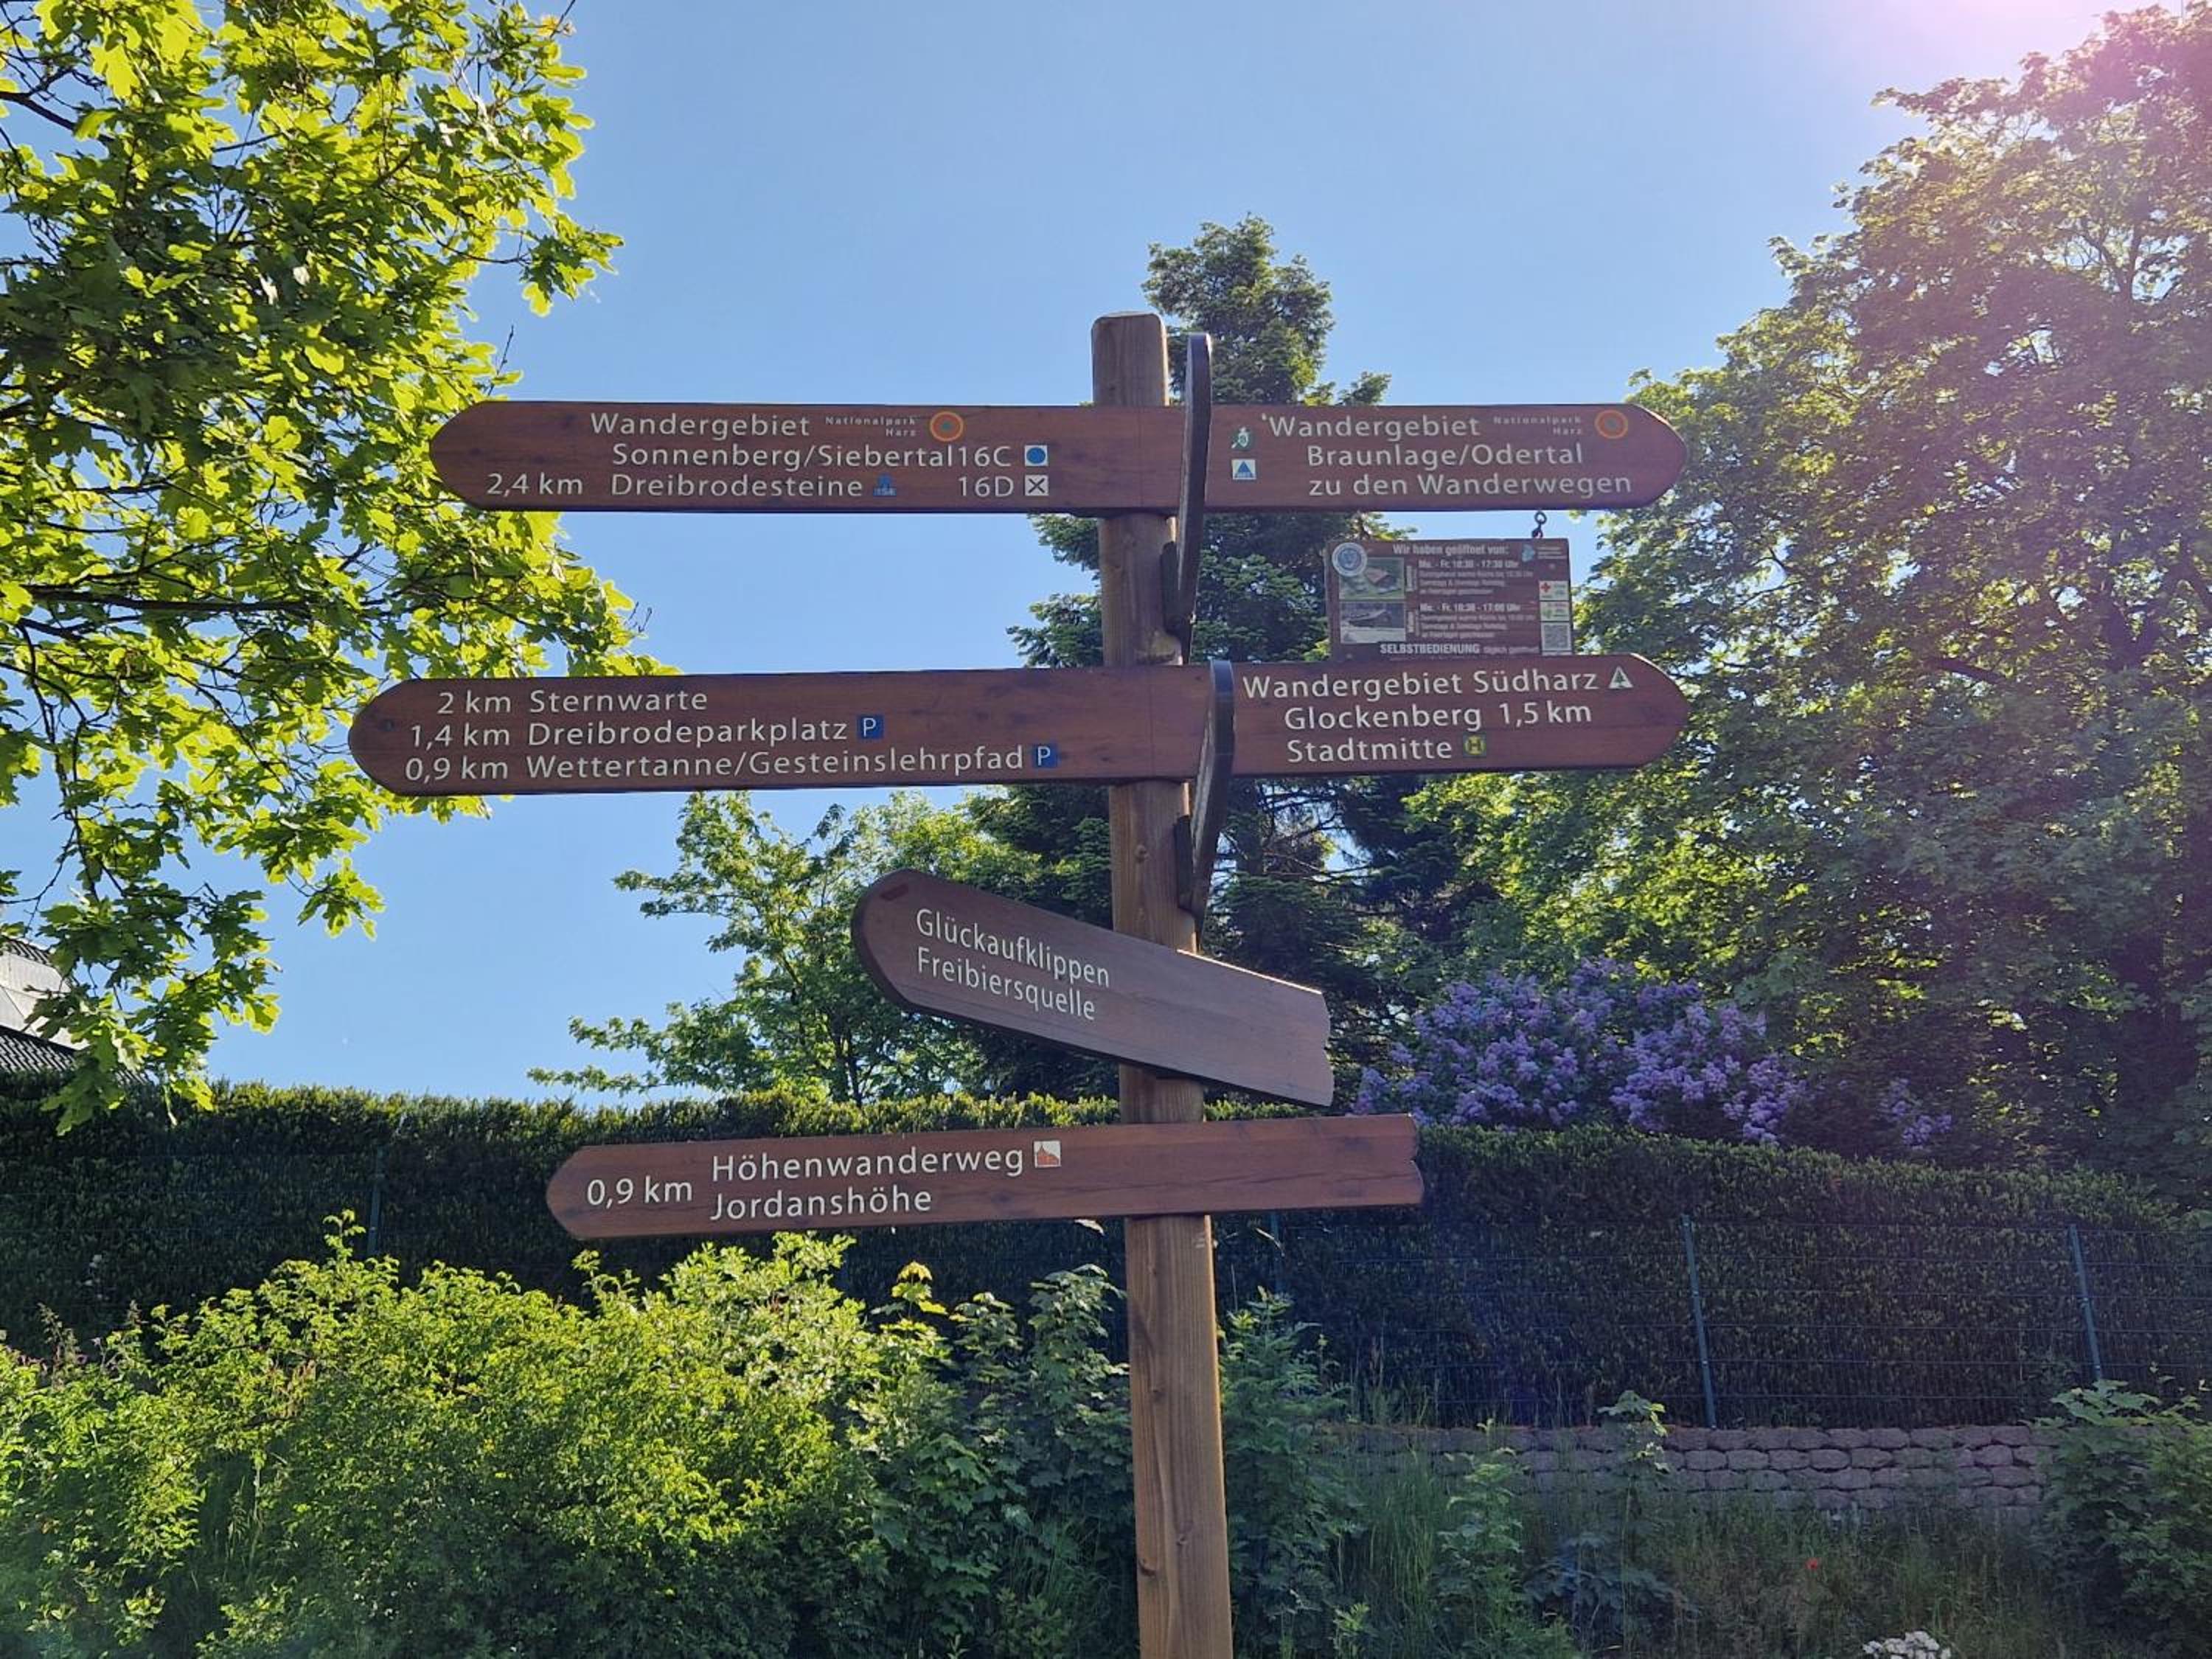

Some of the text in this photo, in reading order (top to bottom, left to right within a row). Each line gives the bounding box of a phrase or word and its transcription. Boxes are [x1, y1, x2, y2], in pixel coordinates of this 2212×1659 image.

[591, 412, 810, 441] Wandergebiet
[825, 415, 915, 427] Nationalpark
[1268, 414, 1480, 442] Wandergebiet
[1493, 415, 1582, 425] Nationalpark
[613, 443, 1011, 470] Sonnenberg/Siebertal 16C
[1307, 442, 1582, 470] Braunlage/Odertal
[487, 471, 1014, 497] 2,4 km Dreibrodesteine 16D
[1309, 473, 1631, 498] zu den Wanderwegen
[1380, 644, 1481, 654] SELBSTBEDIENUNG
[1242, 668, 1599, 702] Wandergebiet Südharz
[437, 689, 707, 714] 2 km Sternwarte
[1284, 700, 1591, 732] Glockenberg 1,5 km
[411, 725, 453, 751] 1,4
[464, 723, 509, 746] km
[529, 717, 847, 747] Dreibrodeparkplatz
[1287, 737, 1452, 762] Stadtmitte
[406, 757, 451, 784] 0,9
[462, 756, 508, 779] km
[526, 746, 1023, 776] Wettertanne/Gesteinslehrpfad
[917, 908, 1110, 988] Glückaufklippen
[917, 947, 1095, 1020] Freibiersquelle
[713, 1146, 1023, 1181] Höhenwanderweg
[587, 1176, 931, 1220] 0,9 km Jordanshöhe
